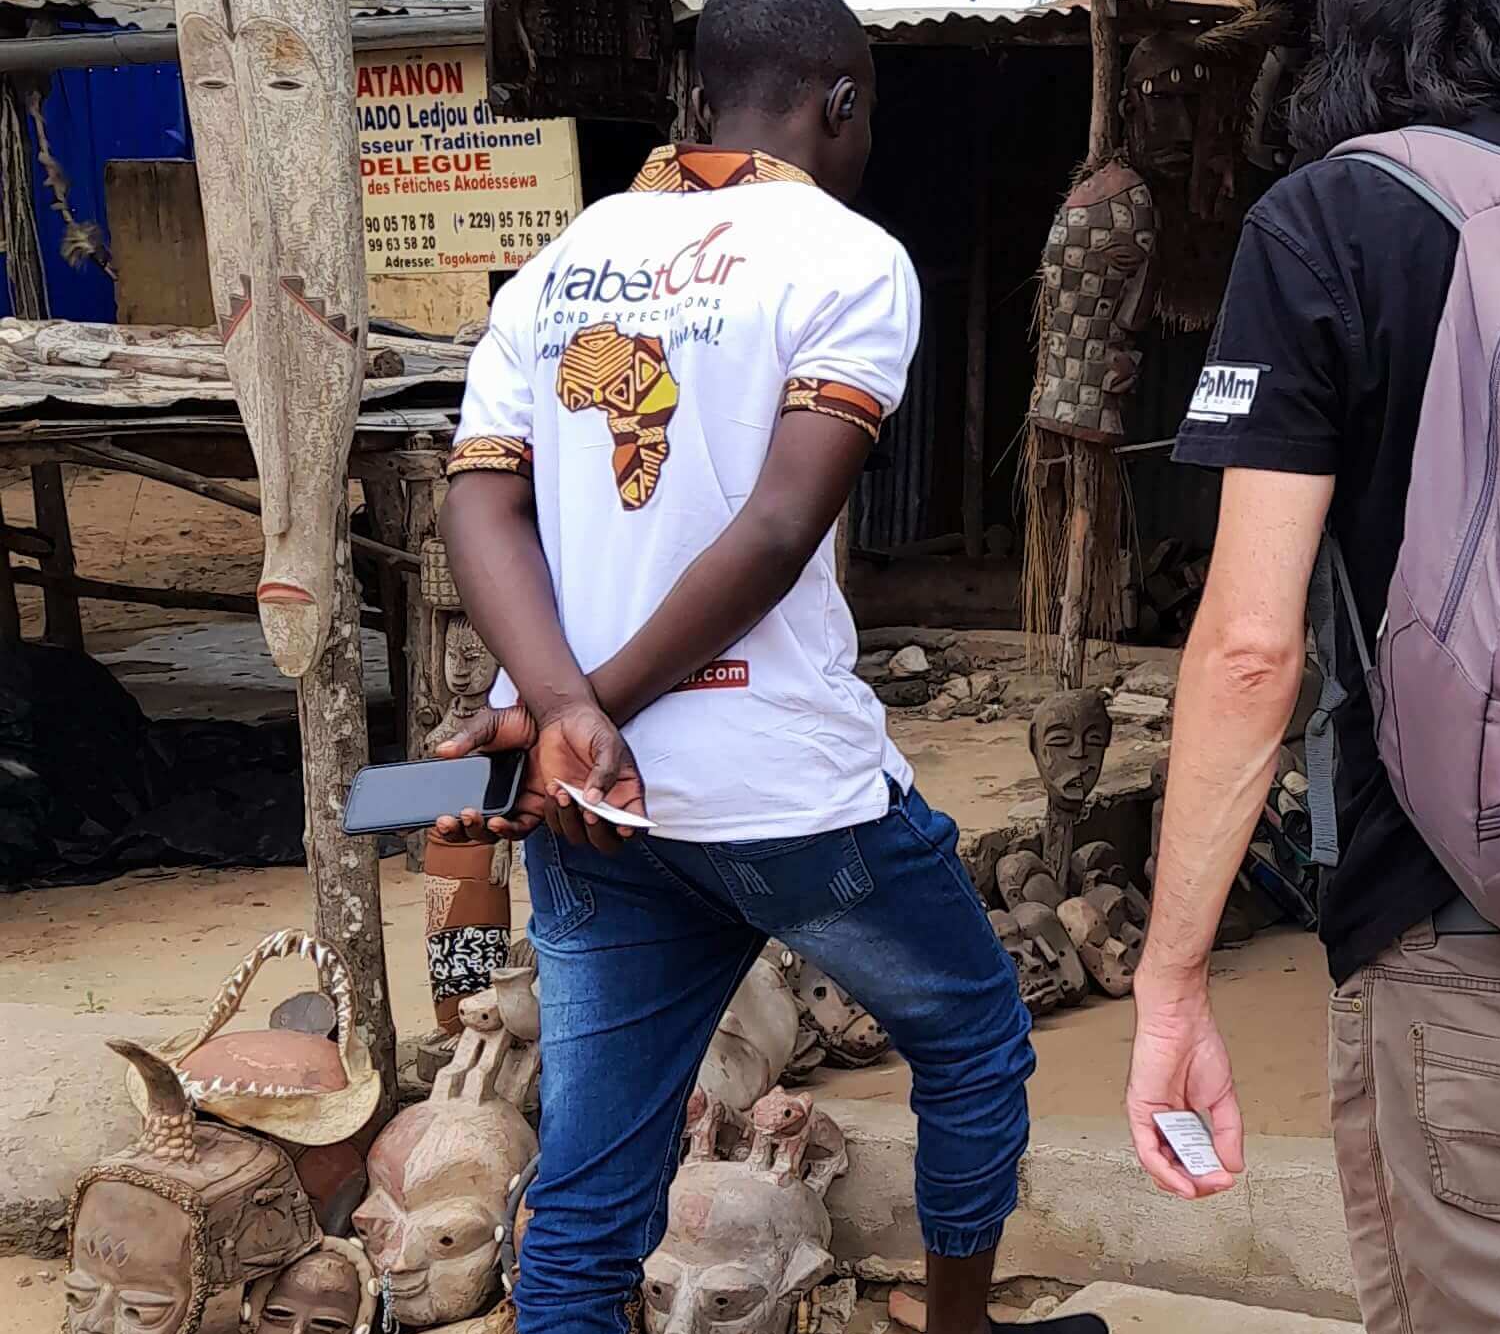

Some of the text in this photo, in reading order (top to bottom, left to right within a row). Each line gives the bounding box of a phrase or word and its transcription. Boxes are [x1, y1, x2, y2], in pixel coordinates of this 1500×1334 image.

[406, 101, 468, 133] Ledjou
[421, 128, 541, 151] Traditionnel
[360, 152, 491, 176] DELEGUE
[367, 179, 390, 195] des
[365, 217, 380, 233] 90
[383, 216, 398, 232] 05
[401, 215, 416, 231] 78
[419, 213, 435, 230] 78
[499, 211, 513, 228] 95
[517, 211, 533, 227] 76
[536, 210, 551, 227] 27
[554, 209, 569, 227] 91
[368, 238, 383, 252] 99
[386, 237, 401, 251] 63
[404, 236, 418, 250] 58
[422, 235, 436, 250] 20
[500, 234, 515, 247] 66
[518, 233, 533, 247] 76
[385, 255, 435, 268] Adresse:
